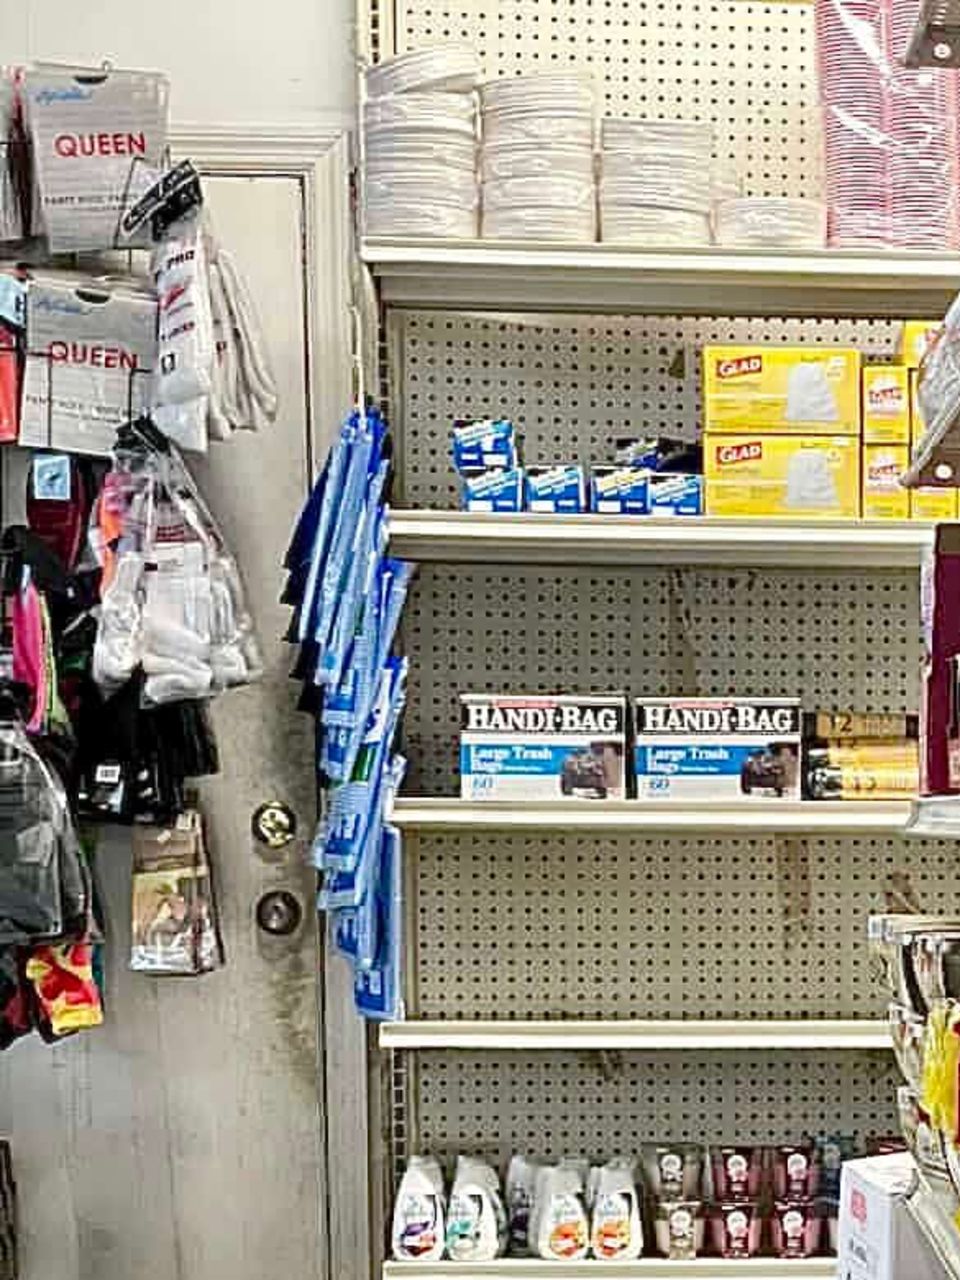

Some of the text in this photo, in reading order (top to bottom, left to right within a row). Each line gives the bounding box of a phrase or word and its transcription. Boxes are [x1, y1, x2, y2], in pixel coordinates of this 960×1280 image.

[54, 131, 146, 157] QUEEN
[49, 340, 139, 369] QUEEN
[719, 357, 762, 377] GLAD
[719, 443, 762, 463] GLAD
[471, 745, 510, 762] Large
[647, 747, 686, 761] Large
